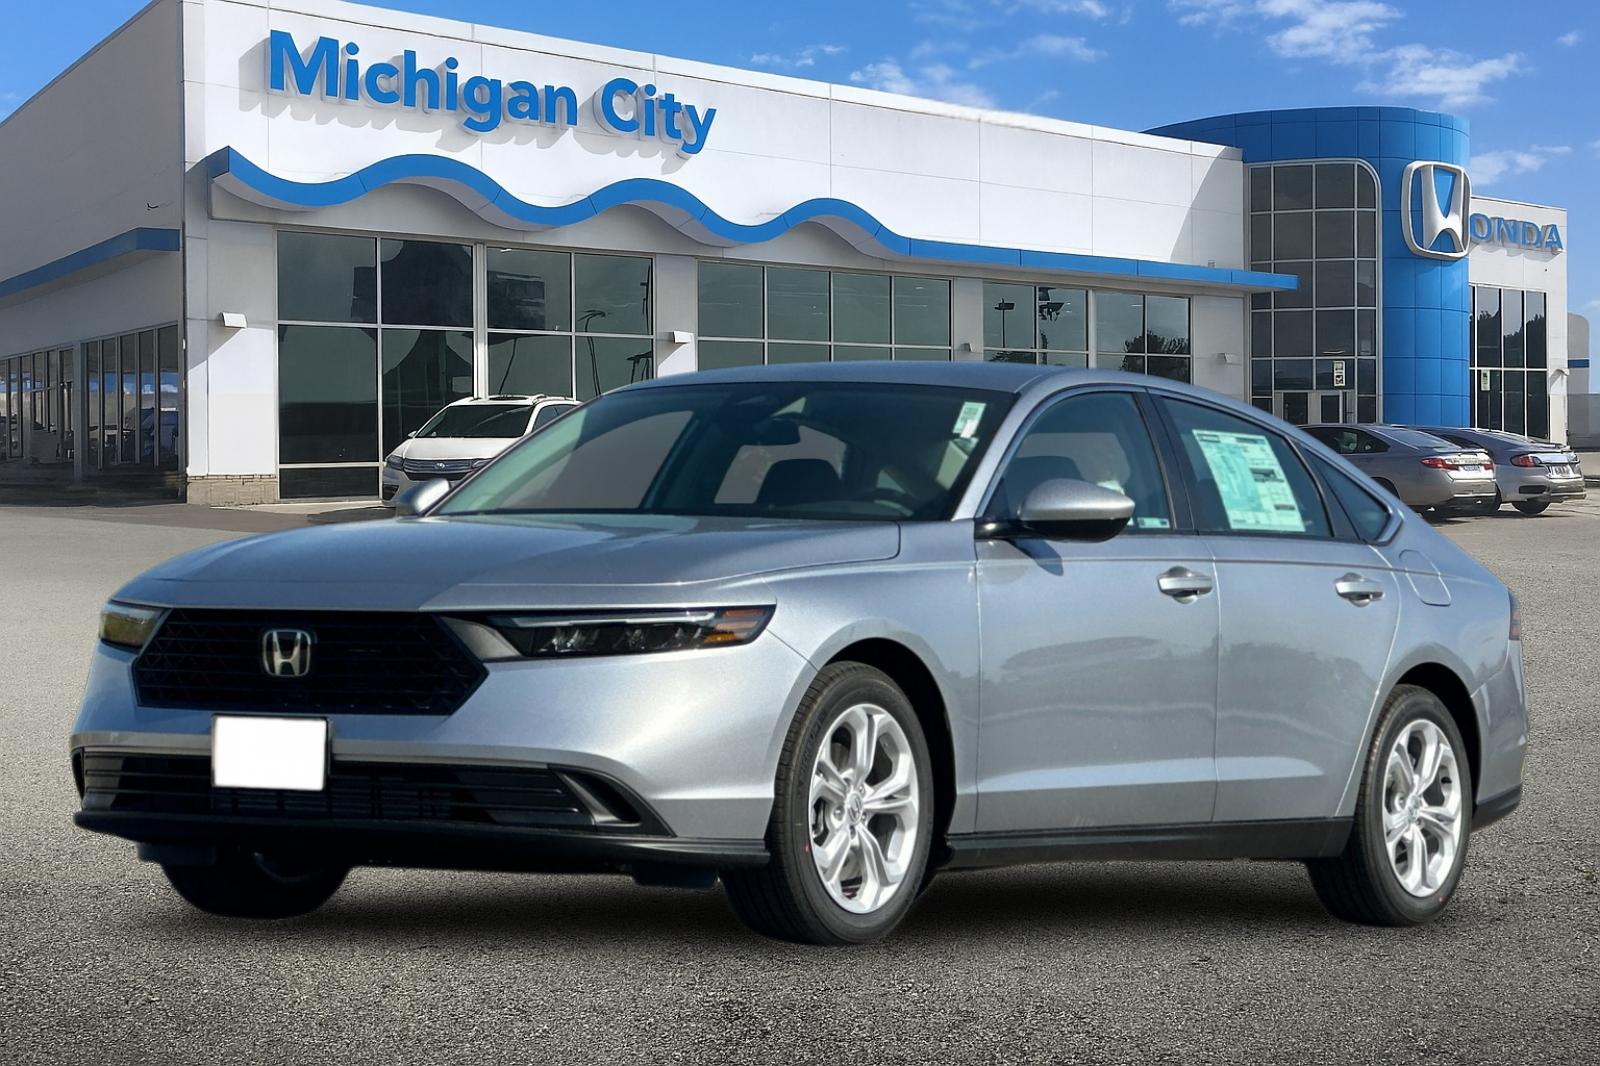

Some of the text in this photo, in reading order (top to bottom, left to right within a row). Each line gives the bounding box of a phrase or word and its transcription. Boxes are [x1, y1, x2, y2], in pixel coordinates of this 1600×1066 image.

[269, 29, 717, 154] Michigan City
[1469, 213, 1564, 249] ONDA
